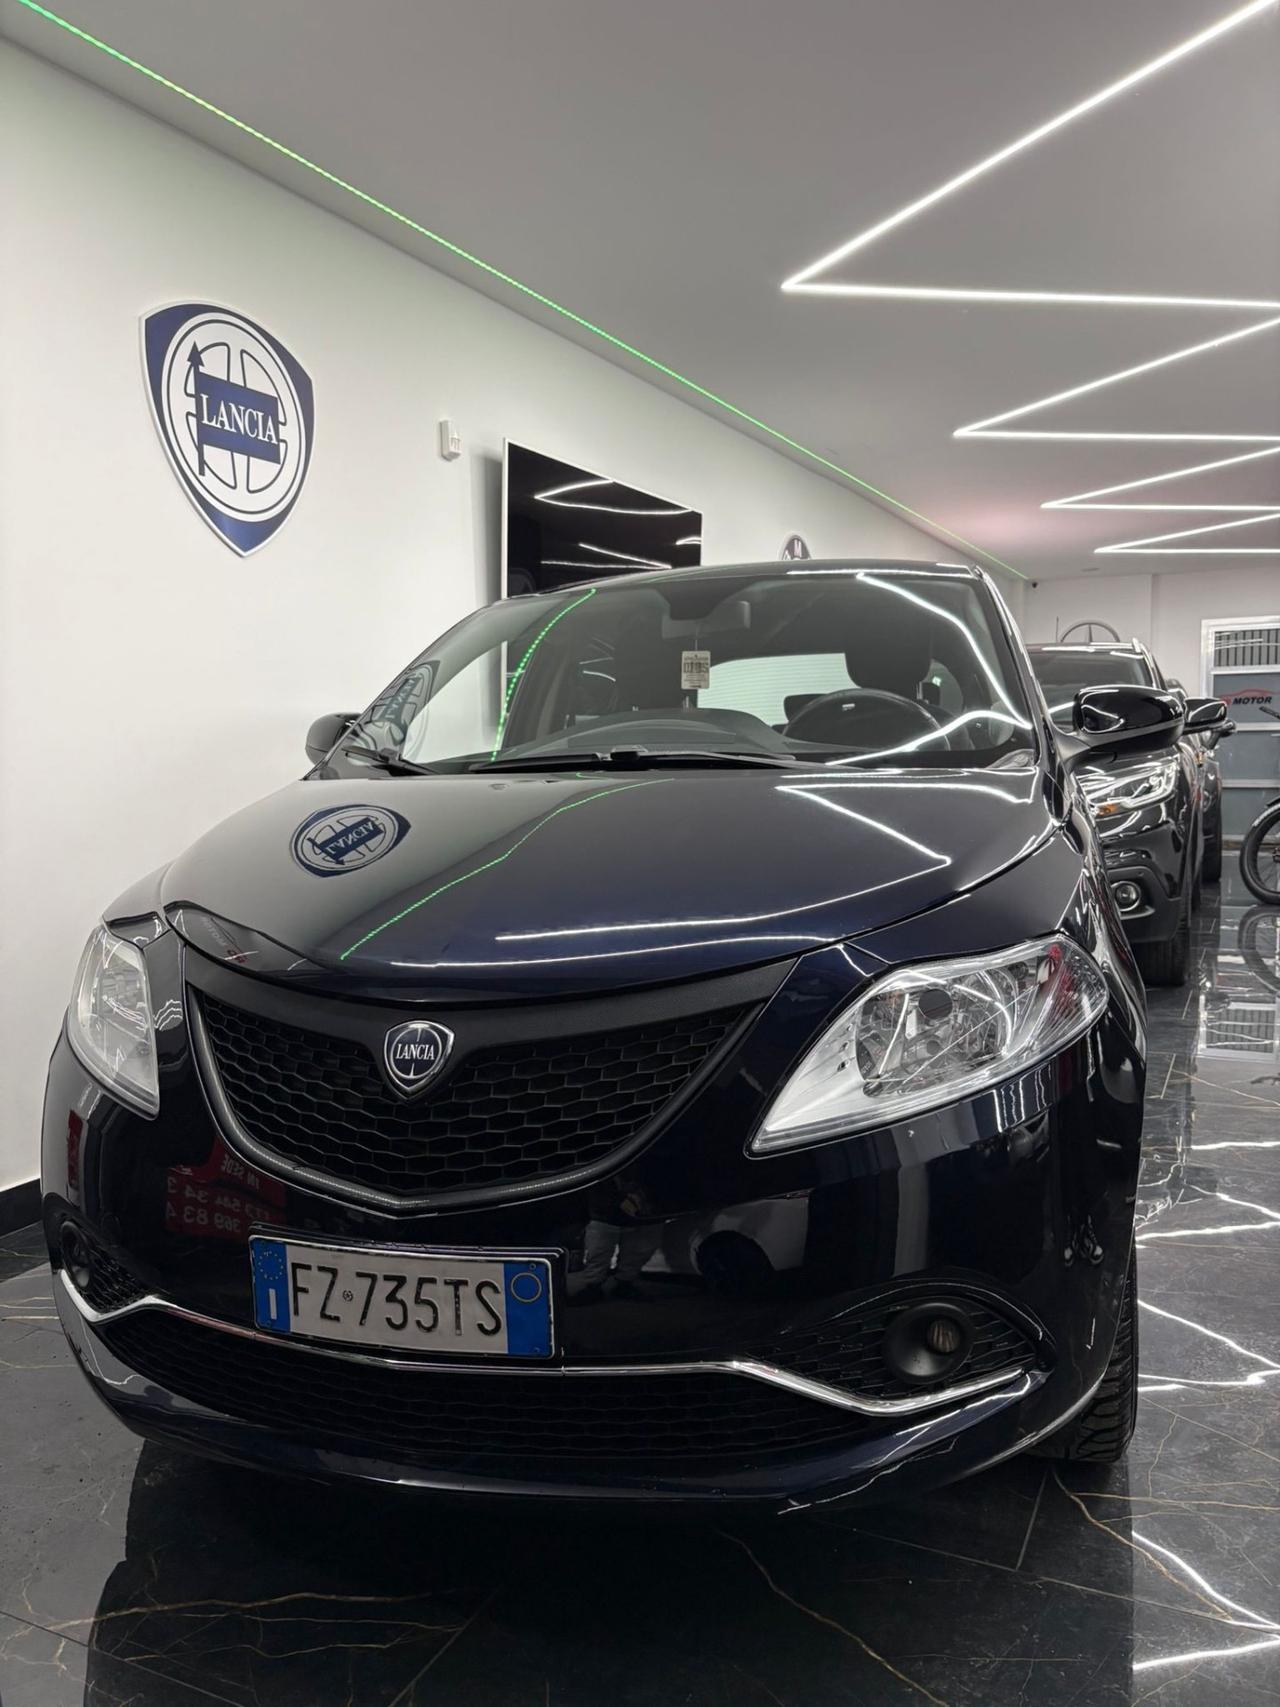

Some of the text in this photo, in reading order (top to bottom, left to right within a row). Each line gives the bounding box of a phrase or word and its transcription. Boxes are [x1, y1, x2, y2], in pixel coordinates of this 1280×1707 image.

[201, 394, 279, 445] LANCIA
[1232, 696, 1272, 705] MOTOR
[395, 1043, 435, 1061] LANCIA
[291, 1262, 502, 1337] FZ 735TS
